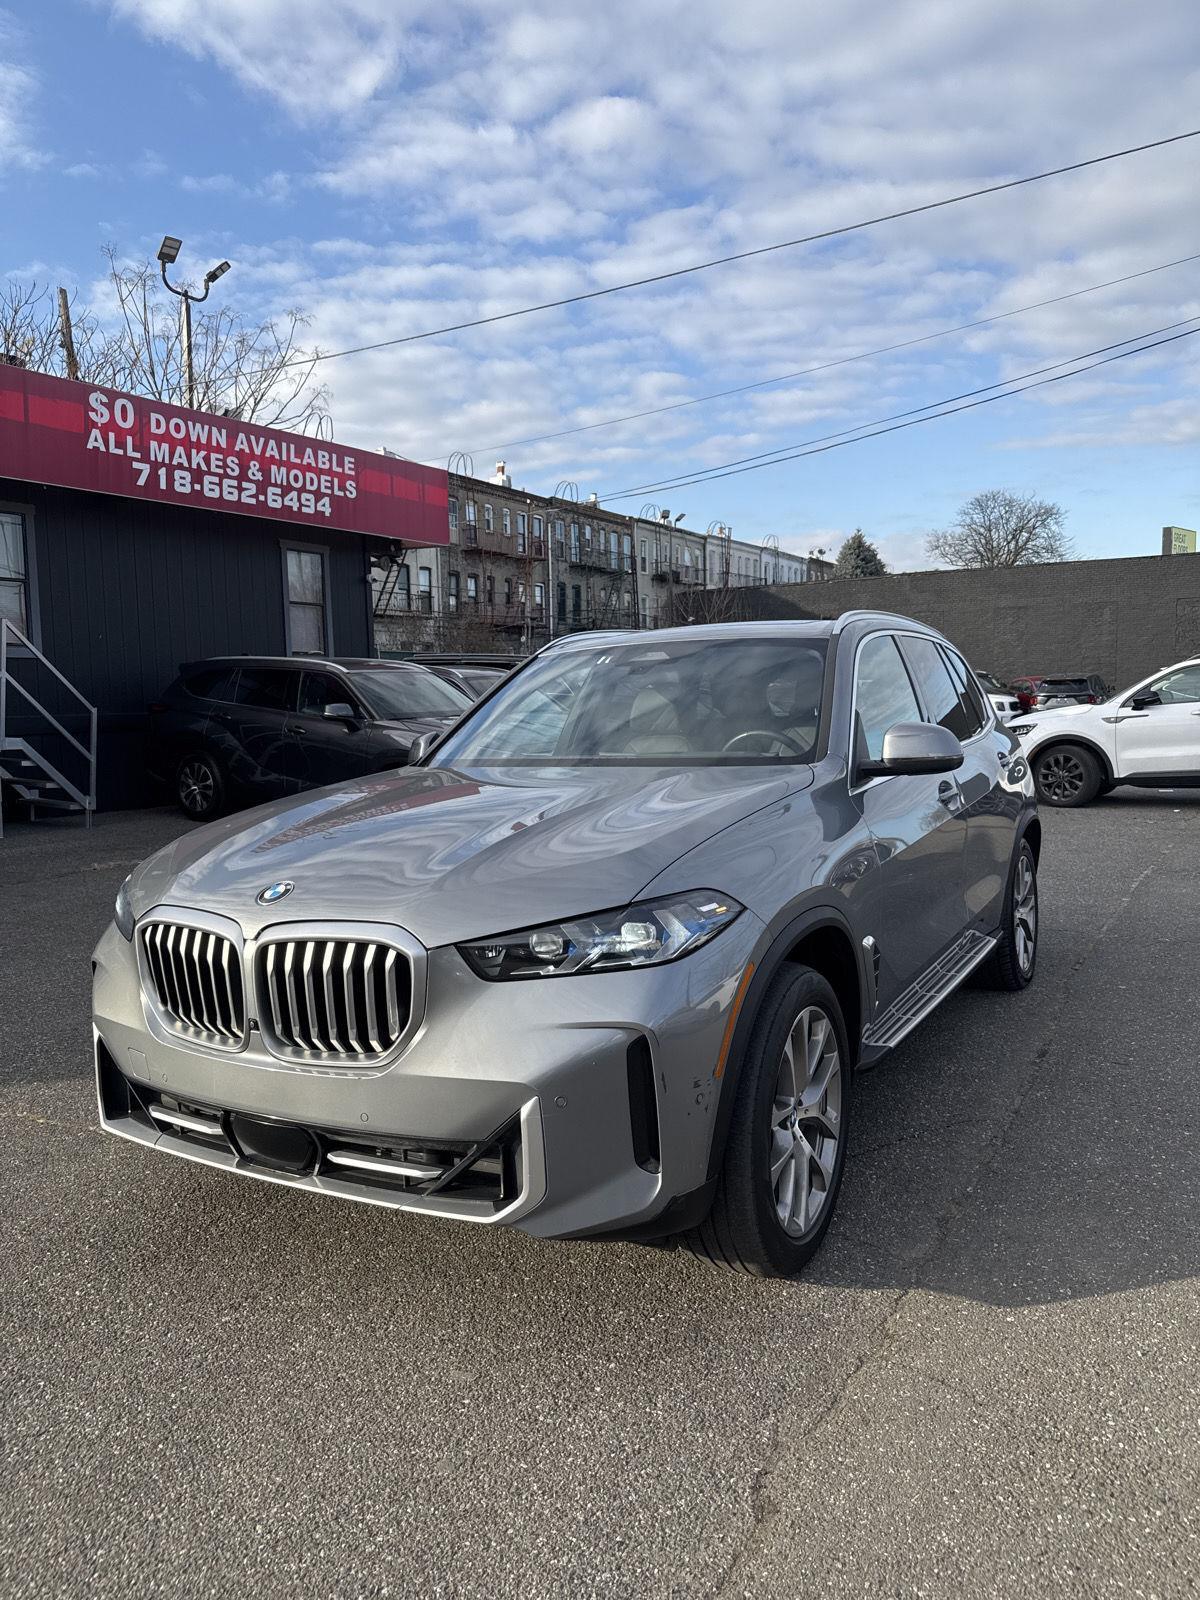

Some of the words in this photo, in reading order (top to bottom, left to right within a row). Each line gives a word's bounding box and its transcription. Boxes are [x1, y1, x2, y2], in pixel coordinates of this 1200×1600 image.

[87, 429, 142, 459] ALL
[149, 440, 240, 477] MAKES
[247, 461, 264, 482] &
[270, 465, 357, 499] MODELS
[88, 391, 135, 429] $0
[150, 413, 227, 449] DOWN
[234, 432, 356, 476] AVAILABLE
[132, 461, 332, 517] 718-662-6494
